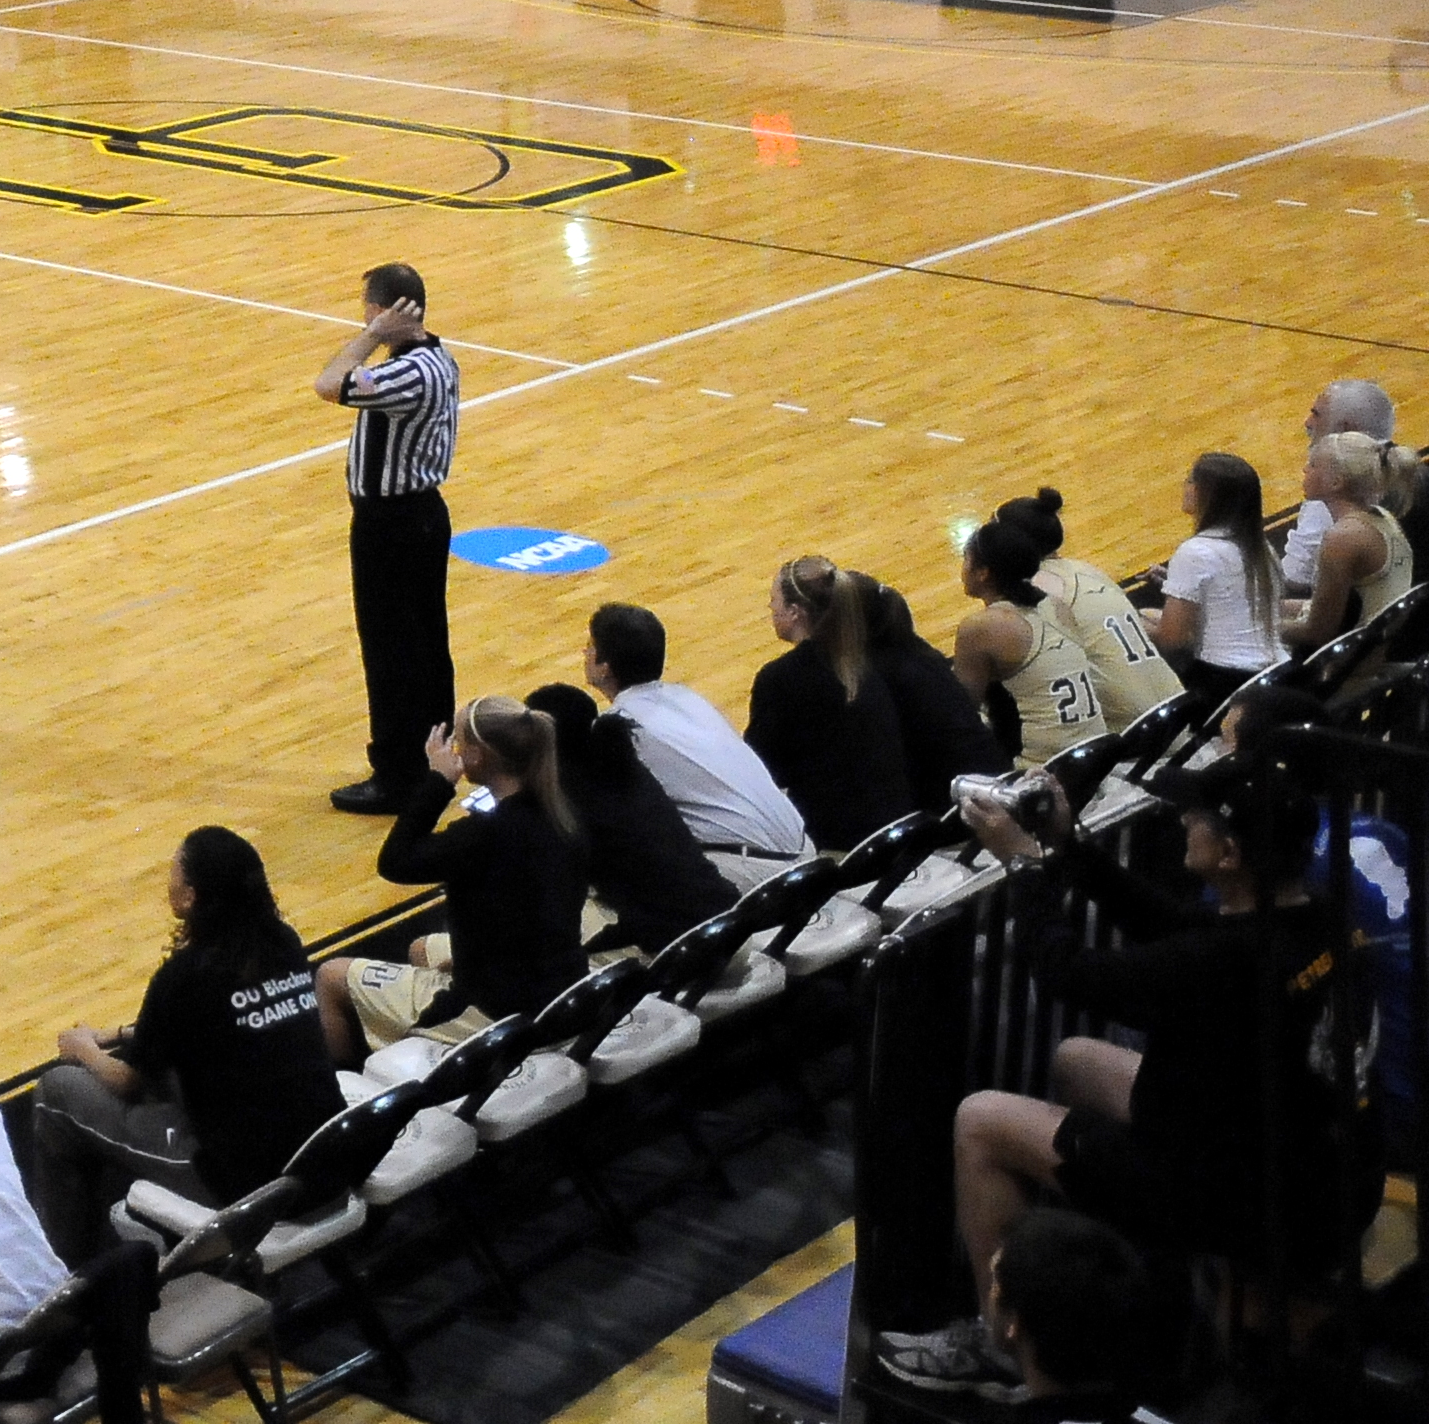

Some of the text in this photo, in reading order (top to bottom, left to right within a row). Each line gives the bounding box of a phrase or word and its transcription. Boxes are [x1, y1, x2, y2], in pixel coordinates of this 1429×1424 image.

[1105, 612, 1158, 664] 11
[1049, 669, 1102, 724] 21
[230, 988, 261, 1009] OU
